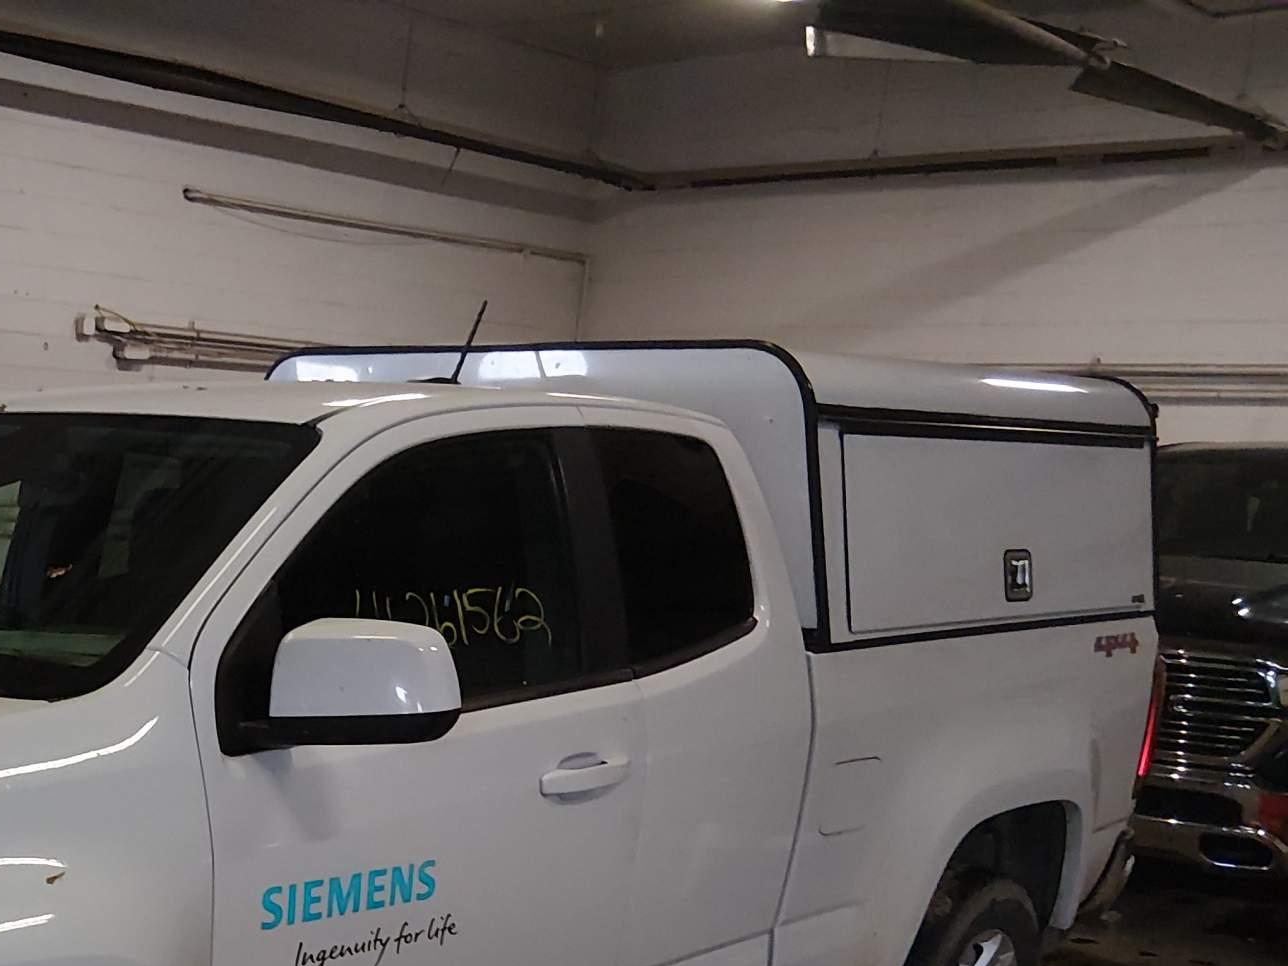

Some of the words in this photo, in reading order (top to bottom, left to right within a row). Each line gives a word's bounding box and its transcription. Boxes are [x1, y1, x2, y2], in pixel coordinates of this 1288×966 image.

[260, 859, 436, 931] SIEMENS
[393, 921, 435, 955] for
[427, 913, 459, 947] life
